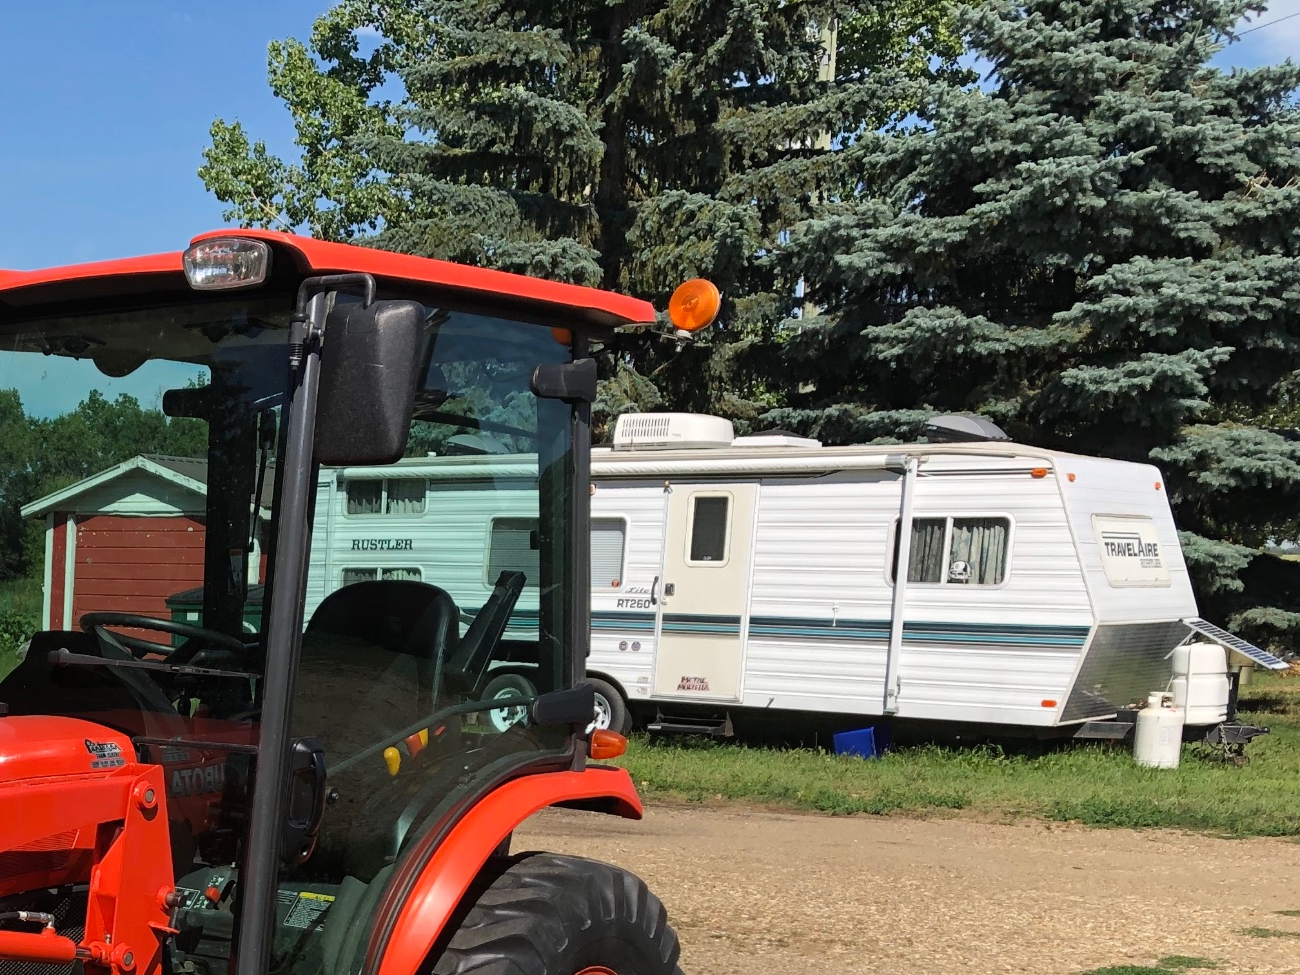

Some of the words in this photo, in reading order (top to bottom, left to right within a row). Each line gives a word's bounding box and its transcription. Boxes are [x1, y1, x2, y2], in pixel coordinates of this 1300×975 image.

[351, 538, 413, 551] RUSTLER
[1104, 539, 1159, 557] TRAVELAIRE
[617, 598, 651, 609] RT260
